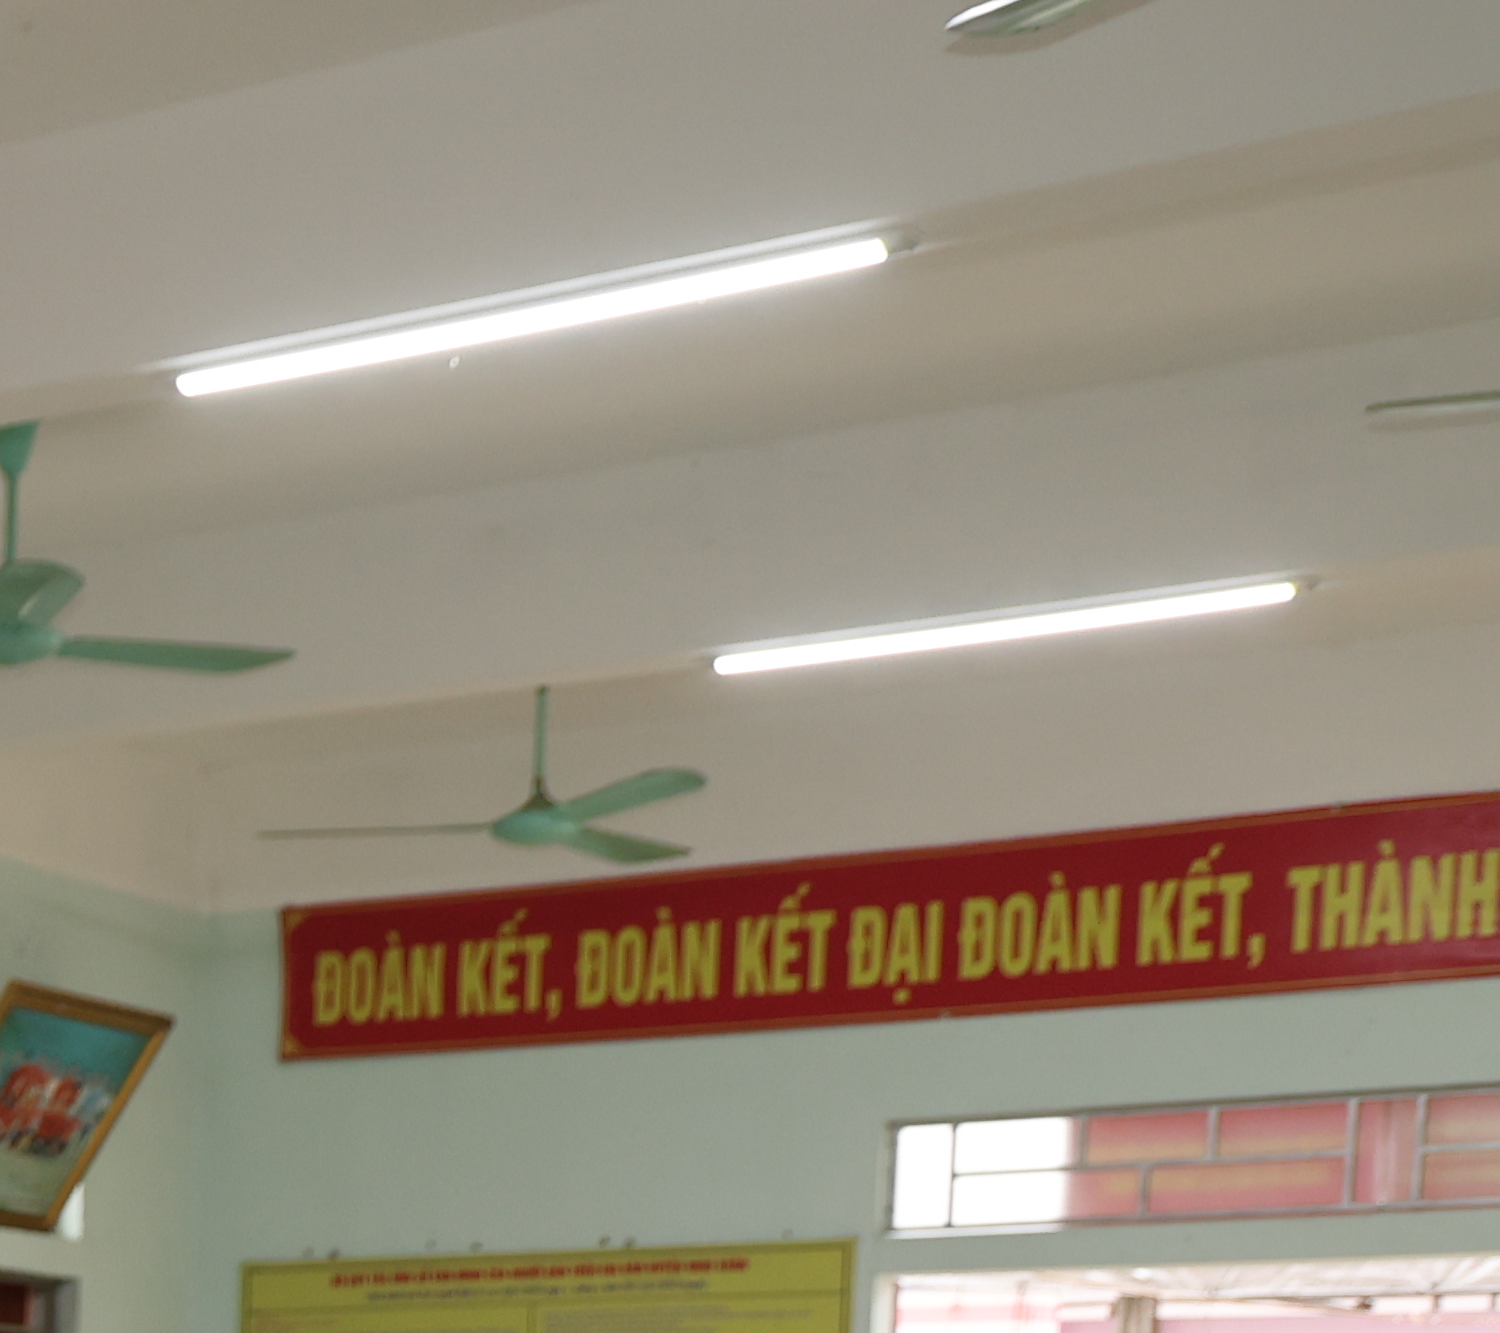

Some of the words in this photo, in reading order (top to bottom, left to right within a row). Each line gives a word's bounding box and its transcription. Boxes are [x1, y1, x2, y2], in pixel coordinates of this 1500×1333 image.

[312, 930, 445, 1026] ĐOÀN
[457, 908, 563, 1022] KẾT,
[575, 906, 721, 1008] ĐOÀN
[732, 882, 836, 996] KẾT
[847, 900, 943, 1005] ĐẠI
[958, 871, 1122, 980] ĐOÀN
[1136, 843, 1265, 967] KẾT,
[1287, 839, 1500, 953] THÀNH
